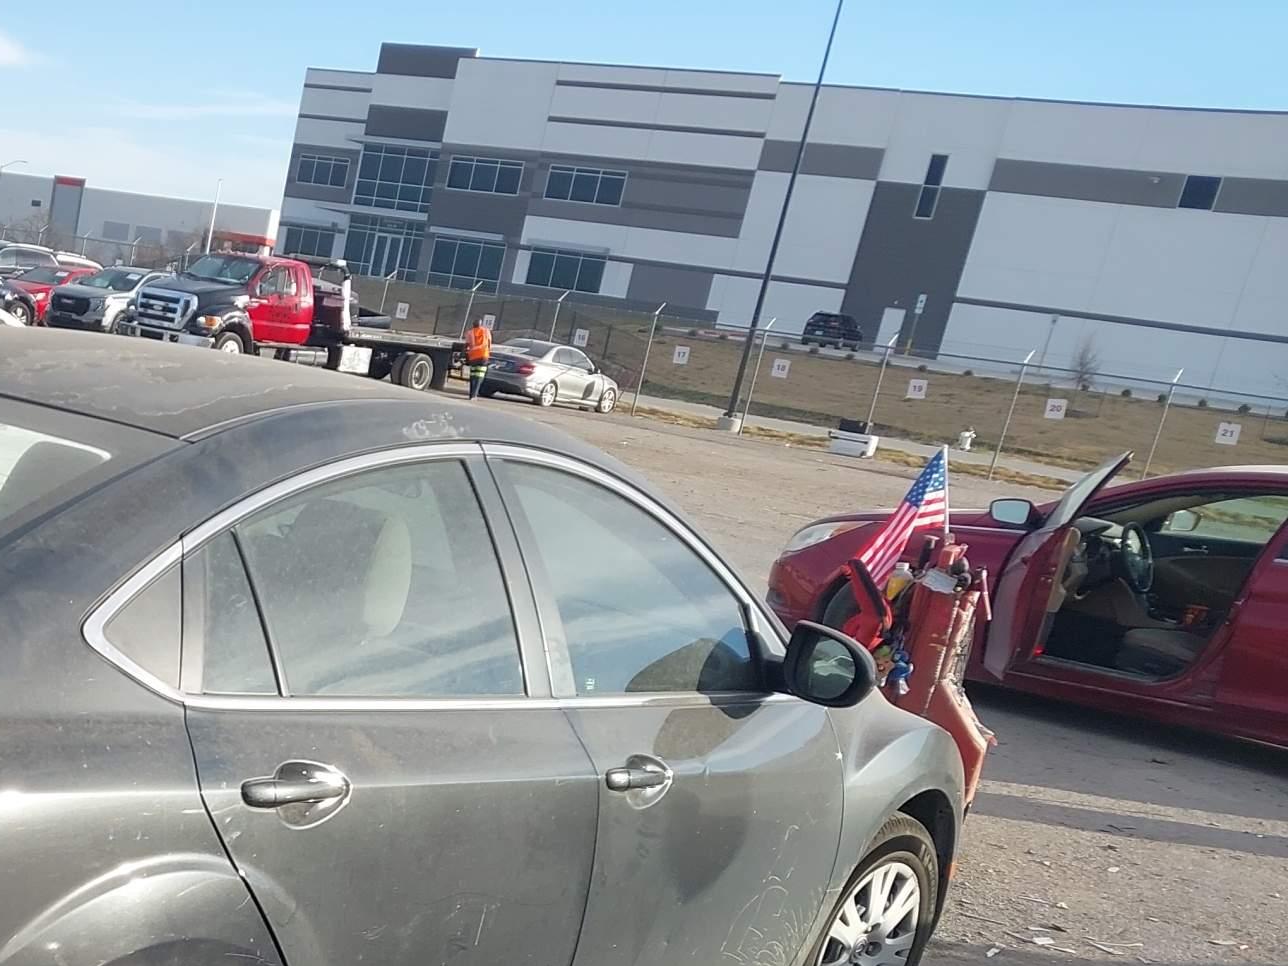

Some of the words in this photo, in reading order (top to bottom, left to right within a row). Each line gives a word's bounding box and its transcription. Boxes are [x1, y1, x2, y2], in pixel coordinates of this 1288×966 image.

[776, 364, 787, 372] 18
[912, 384, 924, 392] 19
[1048, 404, 1063, 412] 20
[1221, 429, 1235, 438] 21
